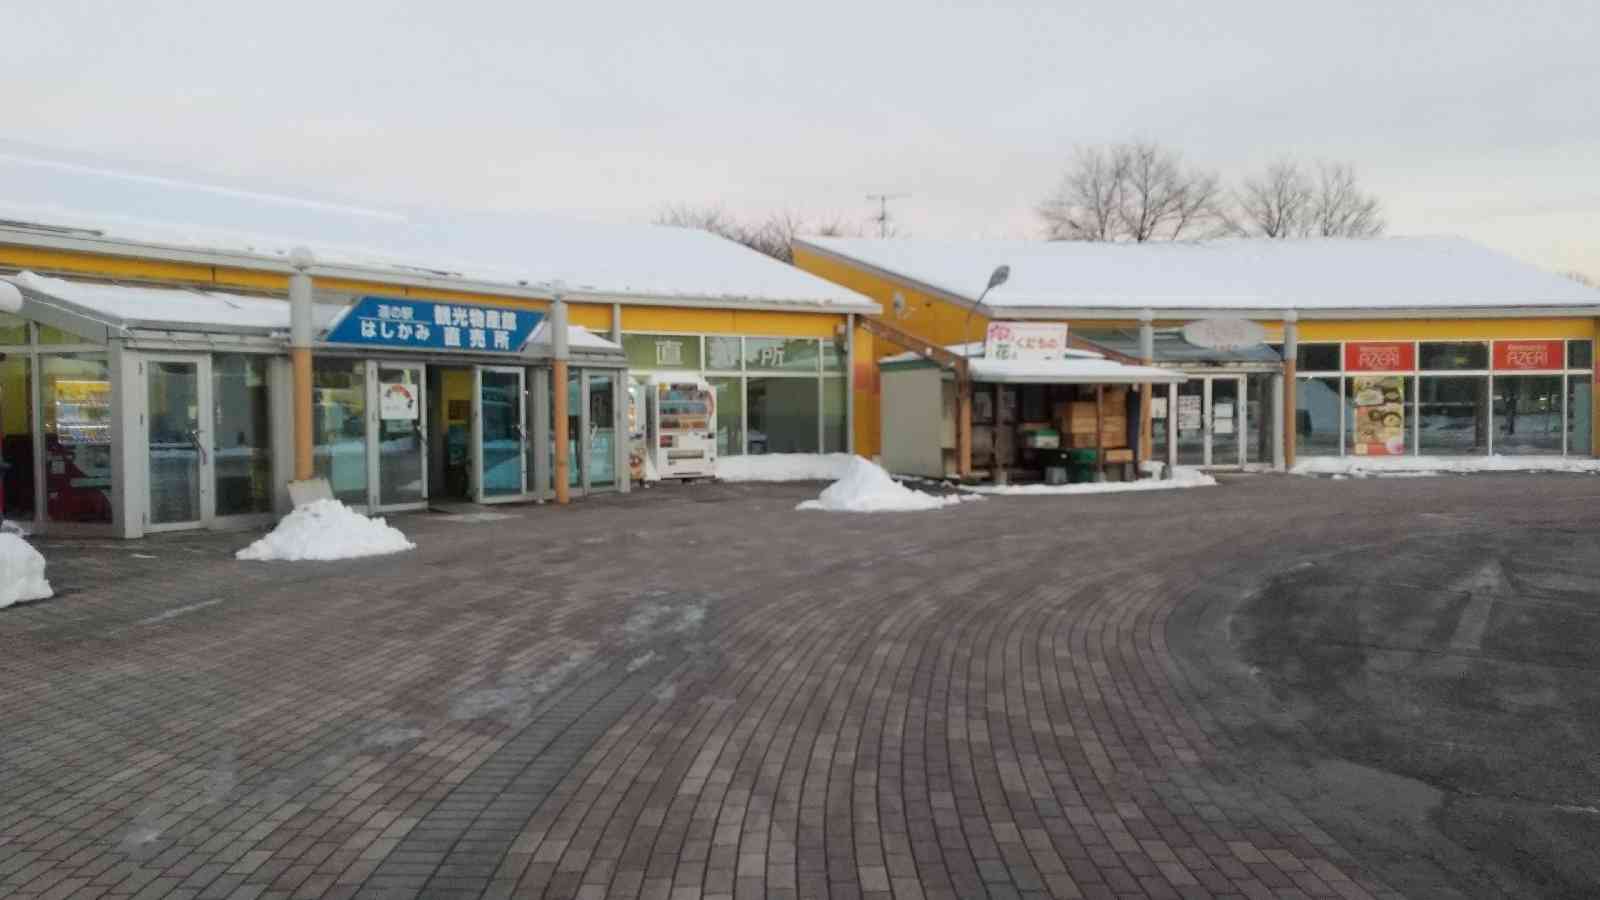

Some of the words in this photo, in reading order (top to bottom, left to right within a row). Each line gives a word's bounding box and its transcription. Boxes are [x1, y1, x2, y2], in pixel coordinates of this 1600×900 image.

[361, 319, 430, 341] はしかみ
[444, 326, 510, 350] 直売所
